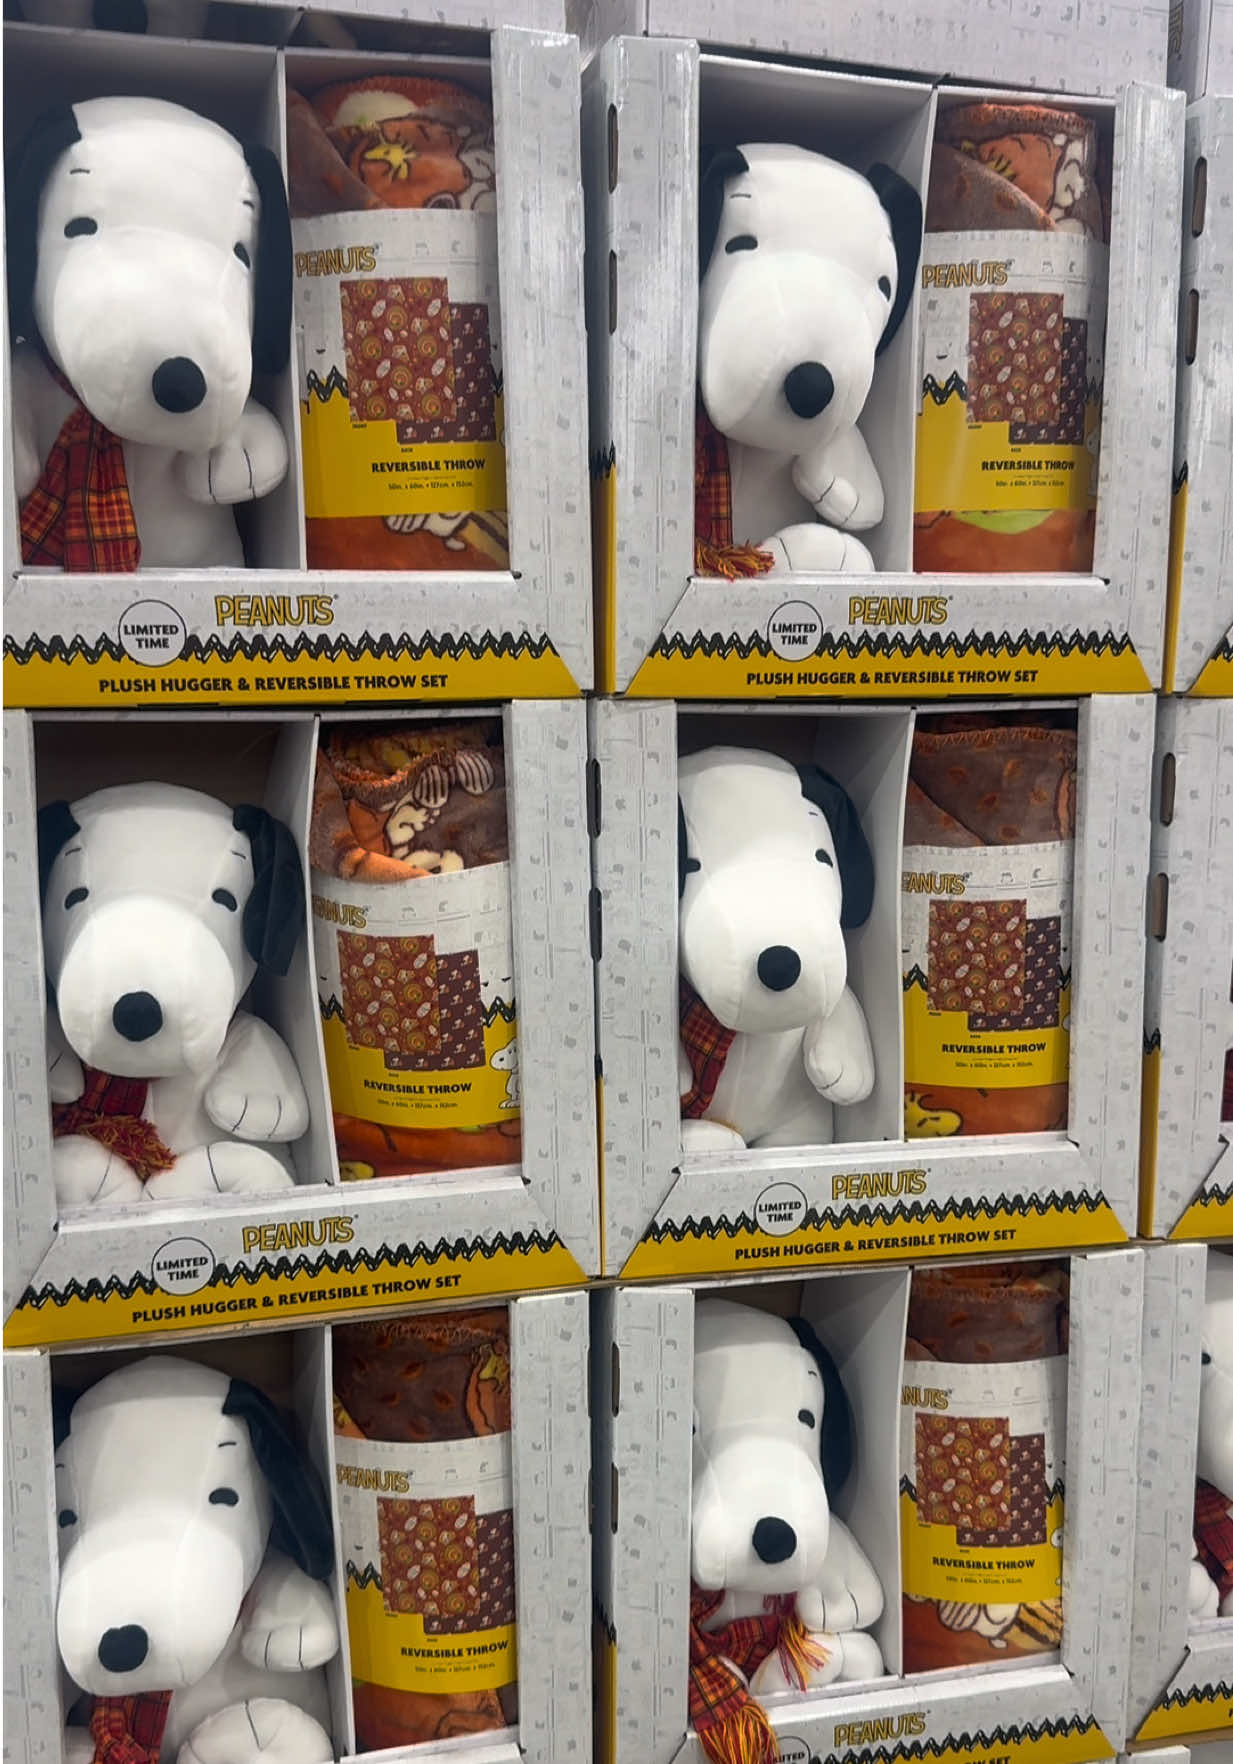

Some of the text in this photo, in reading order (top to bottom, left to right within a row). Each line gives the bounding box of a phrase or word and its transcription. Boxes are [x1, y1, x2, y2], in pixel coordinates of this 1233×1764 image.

[294, 246, 377, 277] PEANUTS
[922, 261, 1009, 289] PEANUTS
[371, 459, 486, 473] REVERSIBLE THROW
[981, 460, 1042, 471] REVERSIBLE
[214, 594, 335, 627] PEANUTS
[848, 596, 950, 626] PEANUTS
[123, 623, 180, 637] LIMITED
[771, 623, 818, 634] LIMITED
[135, 636, 170, 649] TIME
[781, 634, 809, 646] TIME
[99, 674, 449, 693] PLUSH HUGGER & REVERSIBLE THROW SET
[746, 670, 1039, 686] PLUSH HUGGER & REVERSIBLE THROW SET
[902, 871, 966, 896] EANUTS
[942, 1042, 1047, 1054] REVERSIBLE THROW
[363, 1079, 473, 1094] REVERSIBLE THROW
[832, 1169, 928, 1201] PEANUTS
[758, 1201, 802, 1213] LIMITED
[766, 1212, 794, 1223] TIME
[242, 1216, 355, 1254] PEANUTS
[735, 1229, 1017, 1261] PLUSH HUGGER & REVERSIBLE THROW SET
[156, 1256, 209, 1271] LIMITED
[167, 1268, 200, 1282] TIME
[132, 1273, 462, 1323] PLUSH HUGGER & REVERSIBLE THROW SET
[901, 1385, 949, 1411] NUTS
[336, 1463, 410, 1493] PEANUTS
[932, 1556, 1036, 1570] REVERSIBLE THROW
[400, 1639, 509, 1658] REVERSIBLE THROW
[833, 1711, 927, 1748] PEANUTS
